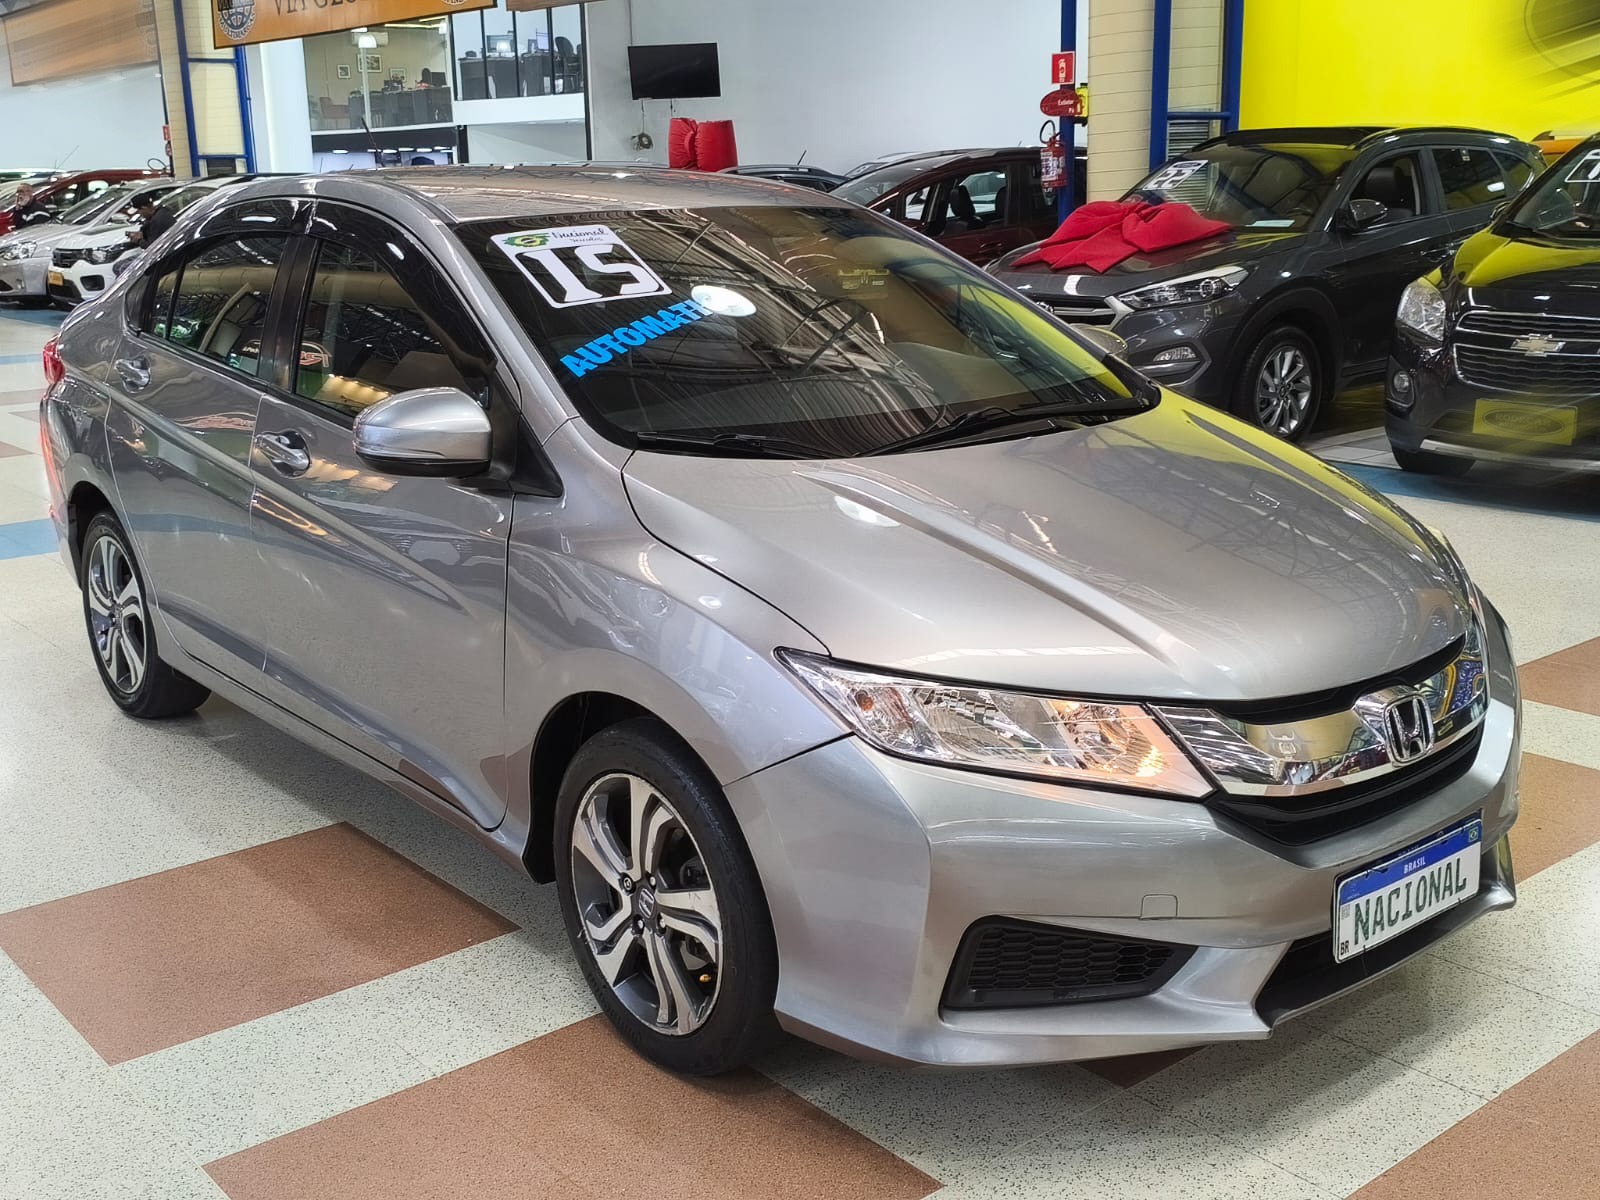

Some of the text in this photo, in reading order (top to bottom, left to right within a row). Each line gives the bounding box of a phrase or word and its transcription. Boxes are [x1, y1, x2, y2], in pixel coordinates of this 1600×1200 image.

[522, 244, 660, 302] 15
[1403, 856, 1426, 874] BRASIL
[1354, 858, 1467, 945] NACIONAL
[1340, 940, 1350, 955] BR
